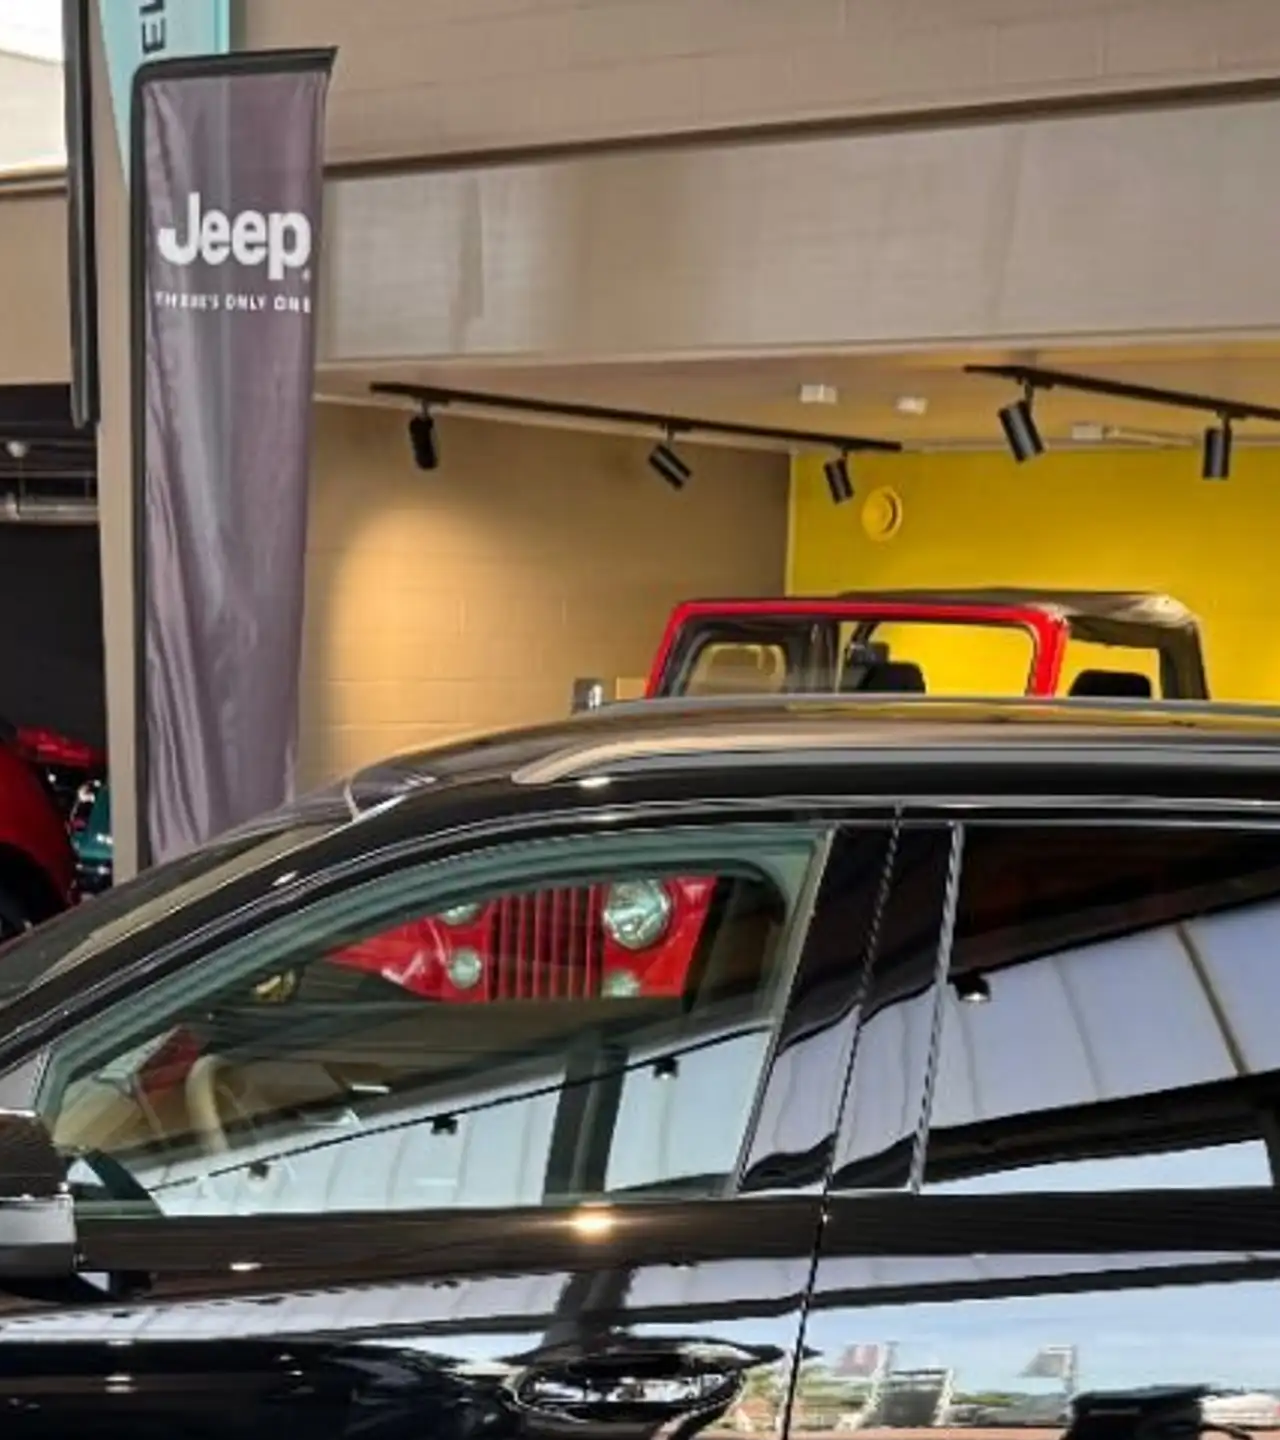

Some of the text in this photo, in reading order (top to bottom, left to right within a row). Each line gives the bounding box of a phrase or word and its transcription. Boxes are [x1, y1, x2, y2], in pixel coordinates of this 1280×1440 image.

[157, 191, 311, 281] Jeep
[224, 292, 268, 312] ONLY
[273, 294, 312, 314] ONE
